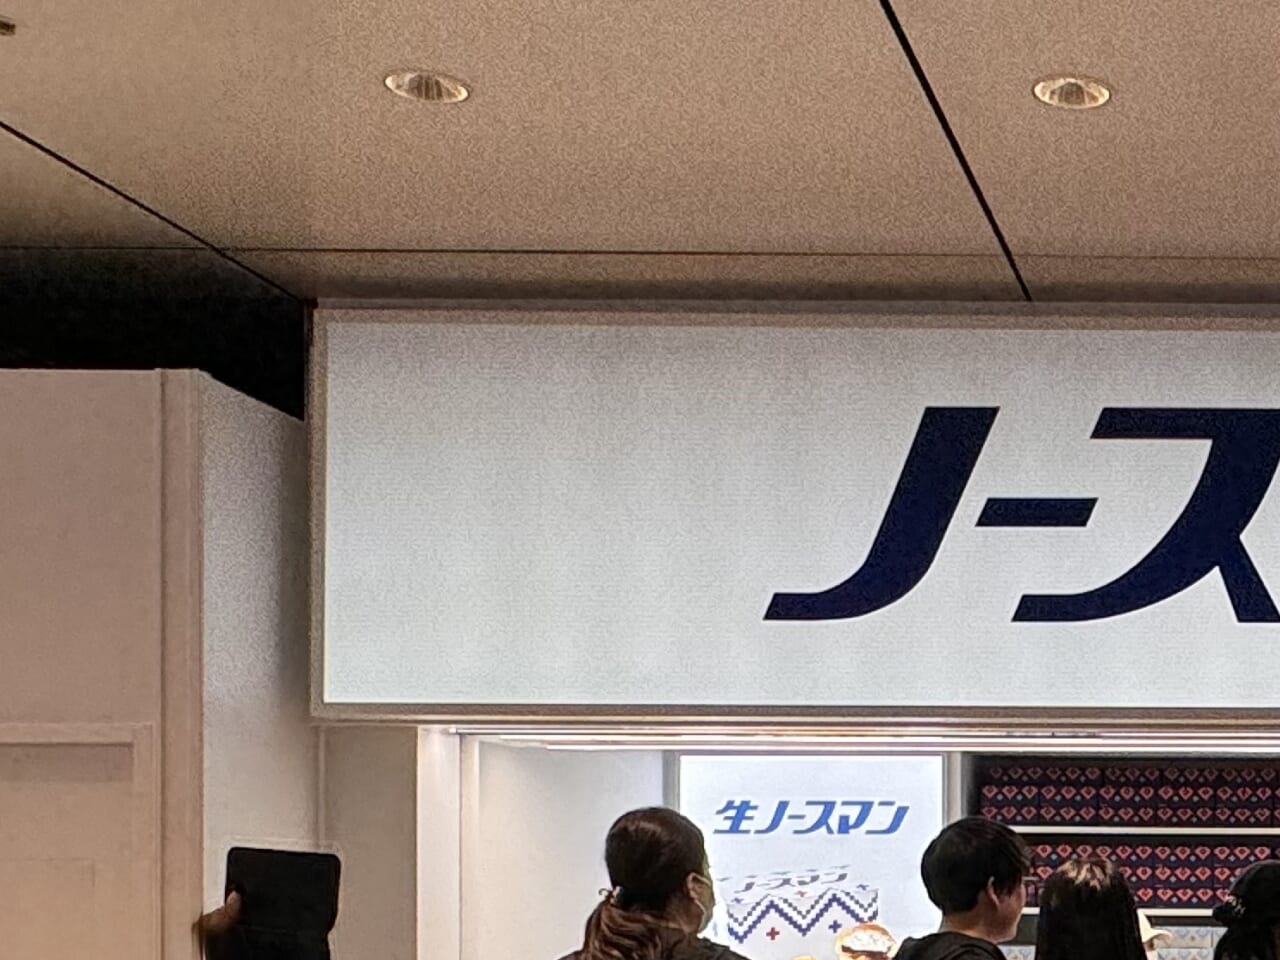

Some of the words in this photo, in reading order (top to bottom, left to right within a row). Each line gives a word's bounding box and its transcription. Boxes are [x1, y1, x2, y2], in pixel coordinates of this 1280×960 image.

[713, 800, 910, 834] 生ノースマン
